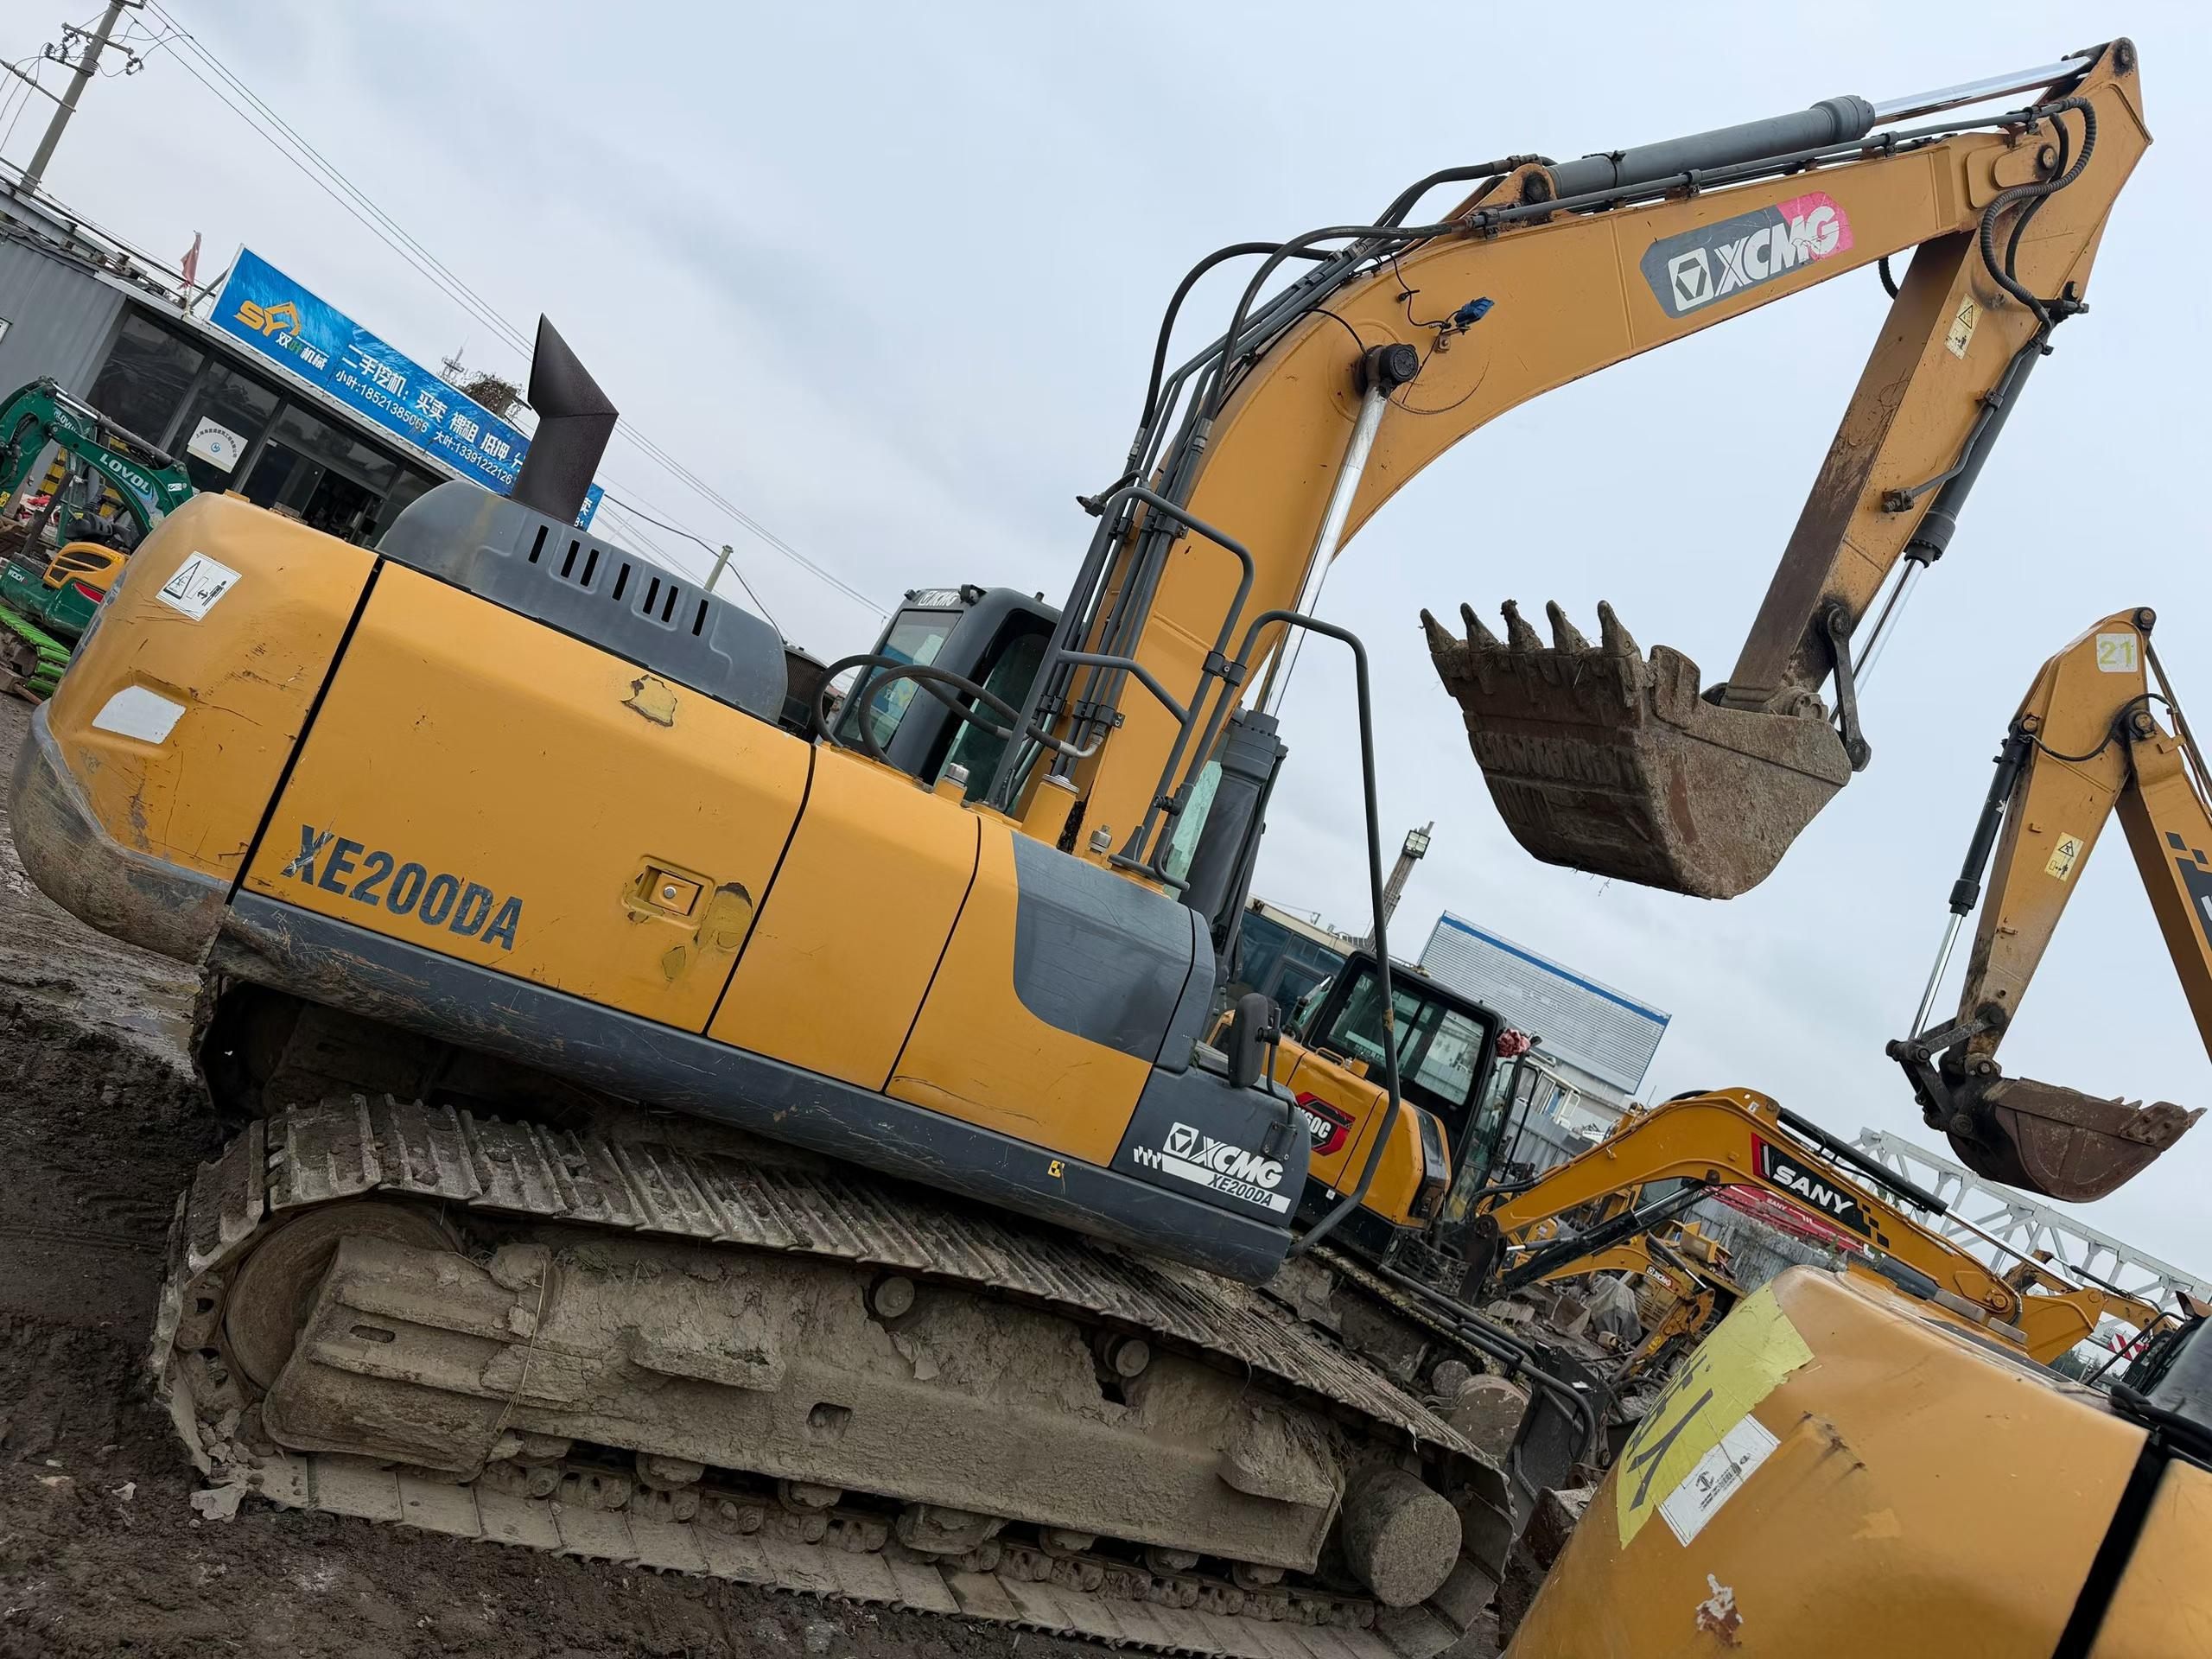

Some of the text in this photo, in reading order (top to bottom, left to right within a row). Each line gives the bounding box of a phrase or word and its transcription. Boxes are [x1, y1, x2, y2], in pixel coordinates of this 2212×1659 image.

[1713, 207, 1840, 296] XCMG
[416, 390, 448, 423] 买卖
[99, 453, 149, 492] LOVOL
[2101, 640, 2133, 664] 21
[281, 823, 524, 951] XE200DA
[1187, 1135, 1283, 1189] XCMG
[1207, 1173, 1274, 1208] XE200DA
[1773, 1165, 1854, 1214] SANY
